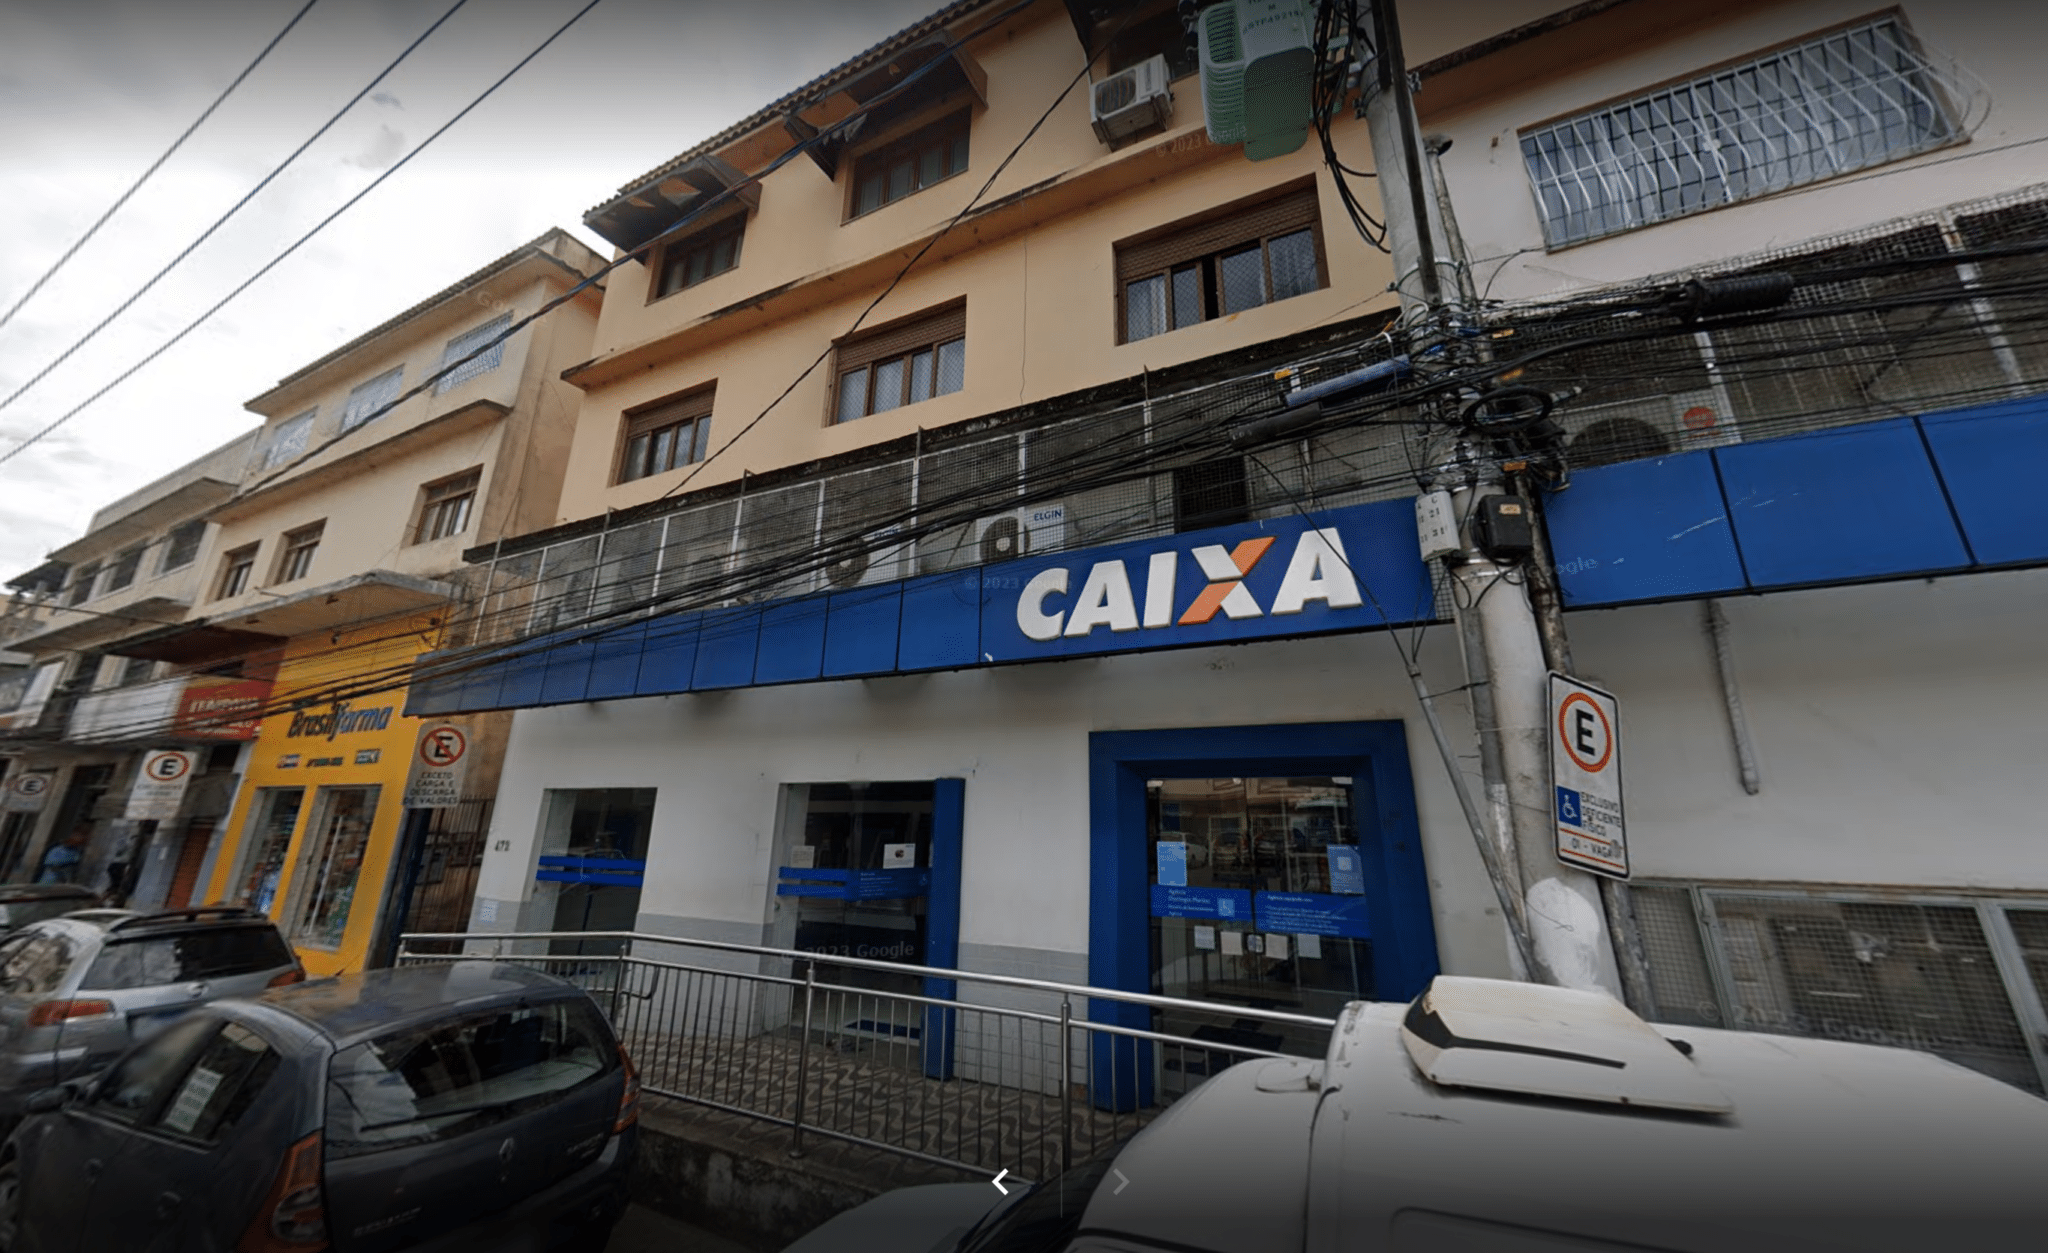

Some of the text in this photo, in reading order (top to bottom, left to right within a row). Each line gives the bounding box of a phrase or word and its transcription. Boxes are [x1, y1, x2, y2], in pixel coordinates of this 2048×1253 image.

[1033, 508, 1063, 522] ELGIN
[1016, 526, 1364, 642] CAIXA
[1575, 708, 1597, 757] E
[434, 735, 454, 758] E
[159, 758, 178, 776] E
[410, 788, 455, 796] DESCARGA
[415, 780, 445, 788] CARGA
[420, 796, 458, 804] VALORES
[1581, 791, 1619, 814] EXCLUSIVO
